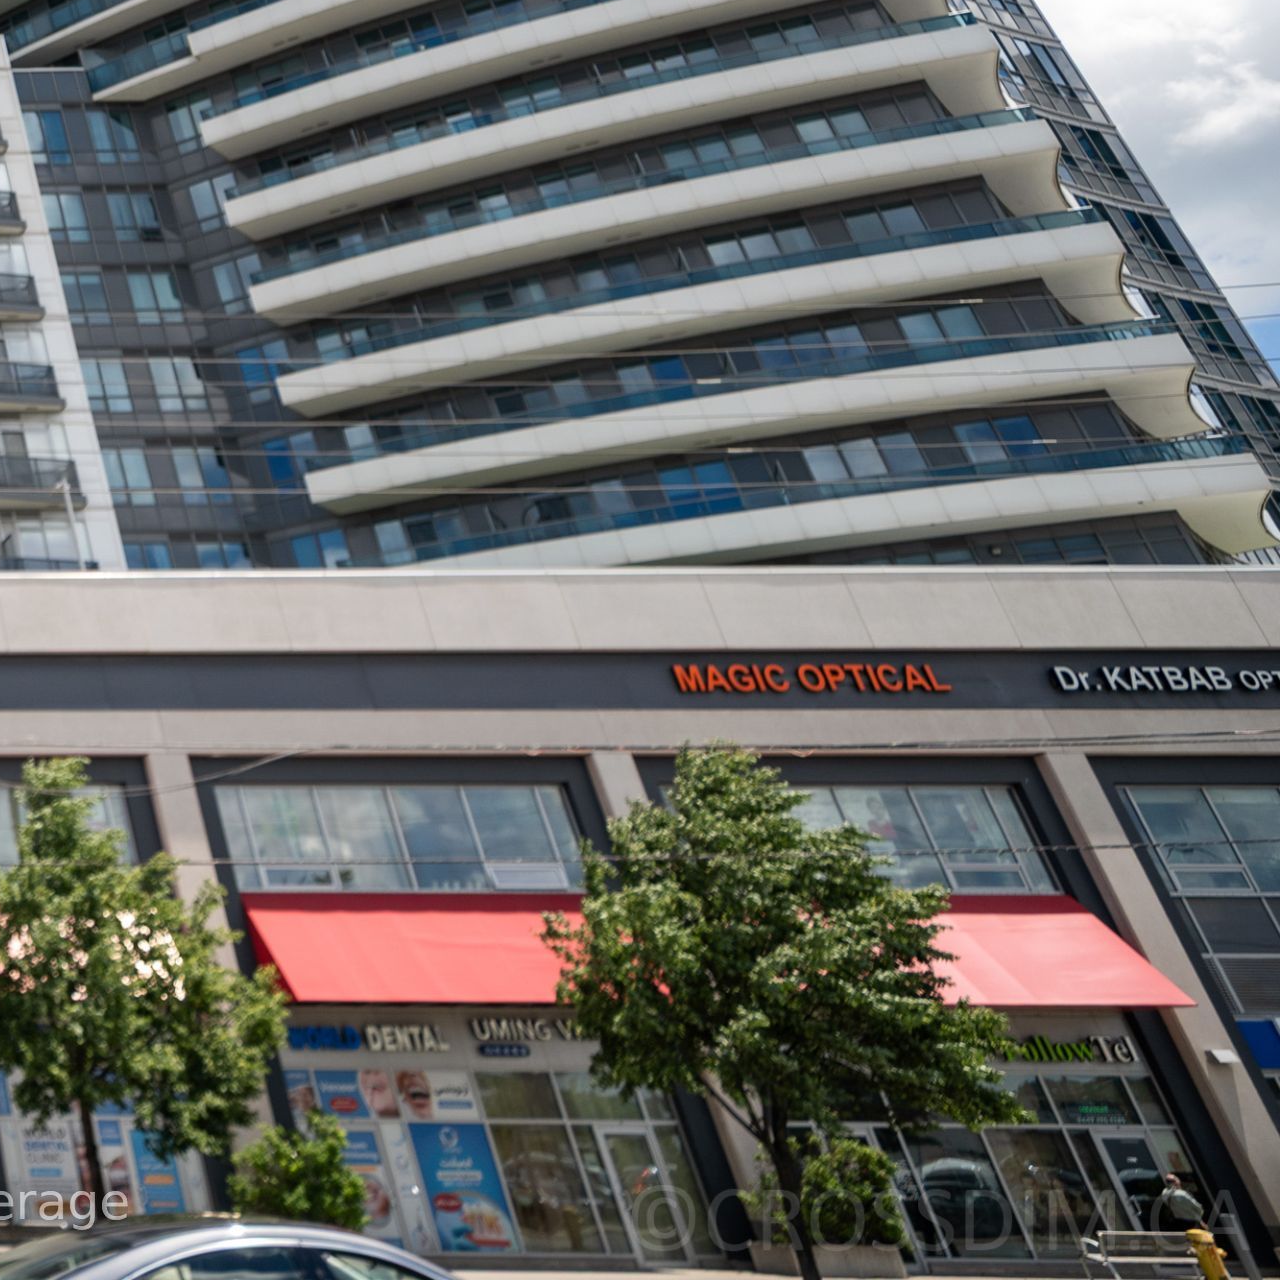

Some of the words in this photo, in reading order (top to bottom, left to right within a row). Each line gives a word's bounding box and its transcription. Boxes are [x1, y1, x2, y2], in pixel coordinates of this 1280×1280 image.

[672, 664, 790, 693] MAGIC
[797, 664, 952, 693] OPTICAL
[1053, 666, 1102, 691] Dr.
[1102, 666, 1232, 691] KATBAB
[288, 1025, 361, 1050] WORLD
[365, 1025, 450, 1052] DENTAL
